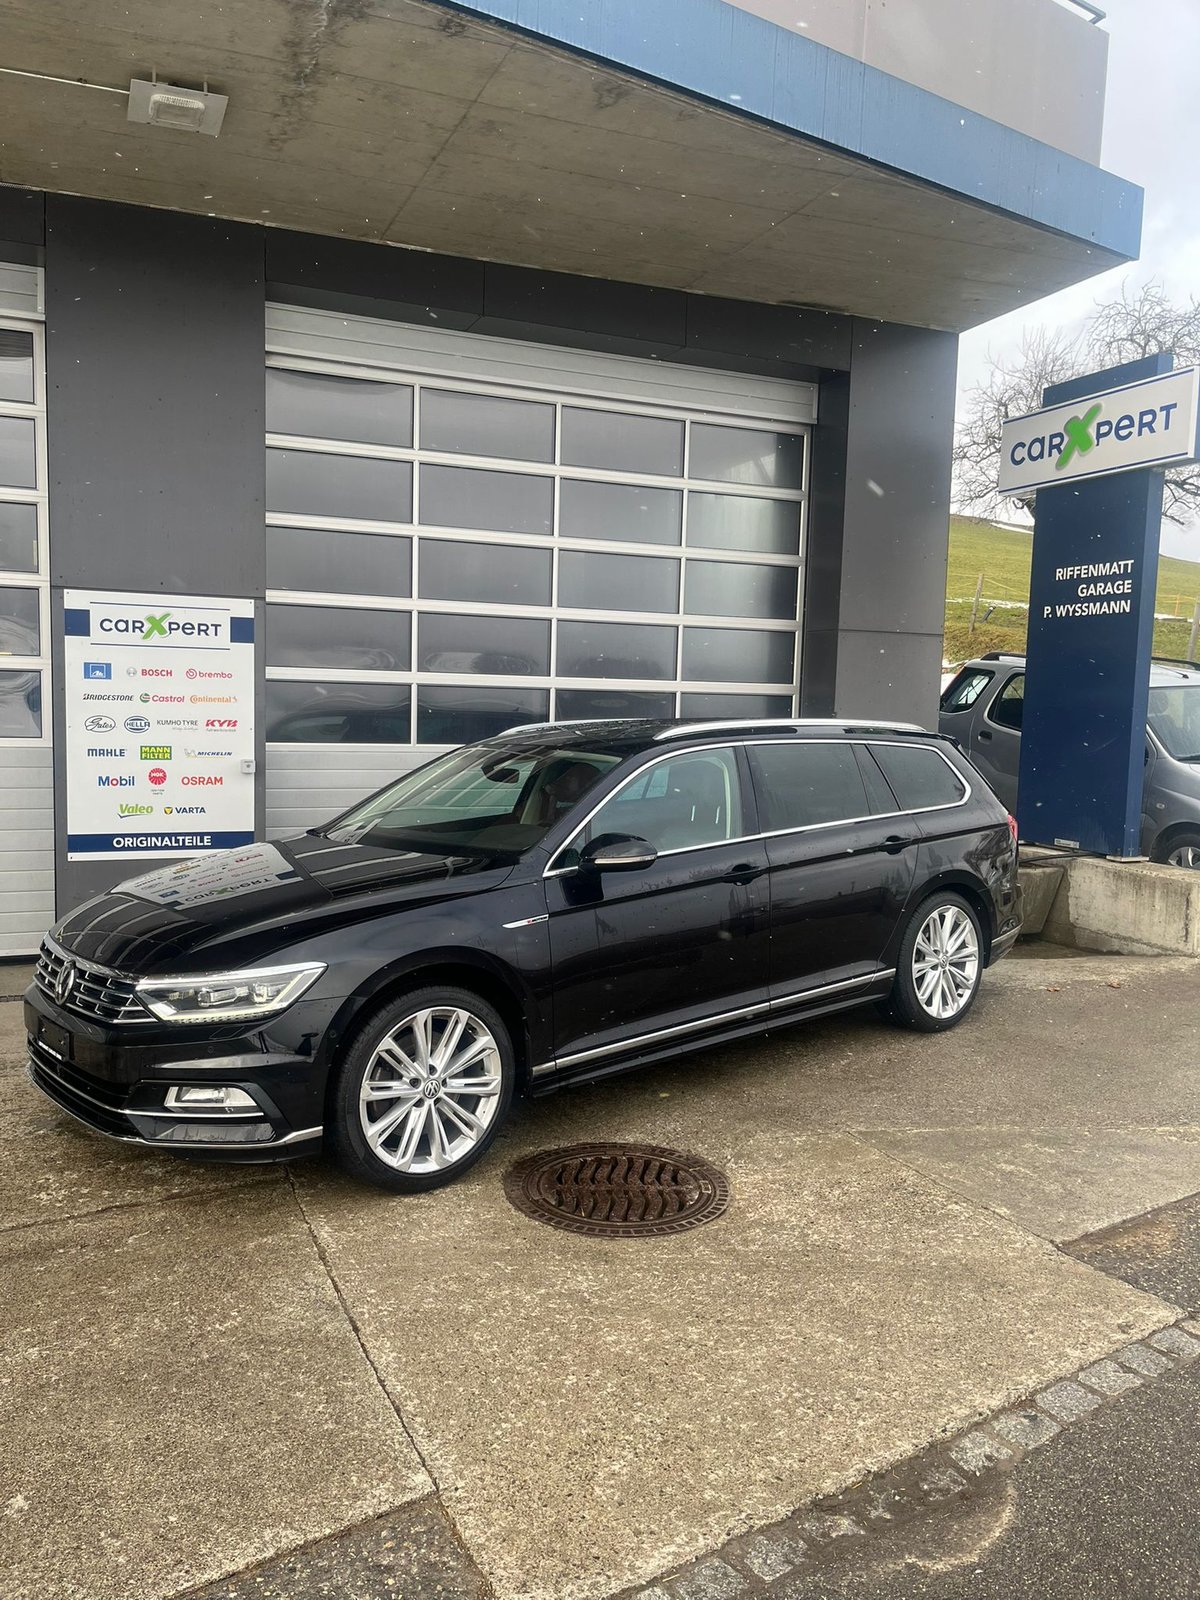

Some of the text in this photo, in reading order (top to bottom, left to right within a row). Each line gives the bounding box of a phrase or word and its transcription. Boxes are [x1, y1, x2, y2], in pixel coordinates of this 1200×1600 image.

[1055, 559, 1135, 581] RIFFENMATT
[1077, 580, 1132, 598] GARAGE
[1043, 599, 1131, 618] P. WYSSMANN
[141, 668, 173, 677] BOSCH
[198, 670, 233, 679] brembo
[83, 693, 134, 701] BRIDGESTONE
[152, 694, 185, 703] Castrol
[189, 694, 232, 704] Continental
[182, 719, 198, 727] TYRE
[205, 719, 238, 727] KYB
[87, 748, 126, 757] MAHLE
[98, 775, 135, 787] Mobil
[181, 776, 223, 786] OSRAM
[119, 803, 154, 814] Valeo
[175, 806, 206, 814] VARTA
[112, 835, 212, 848] ORIGINALTEILE
